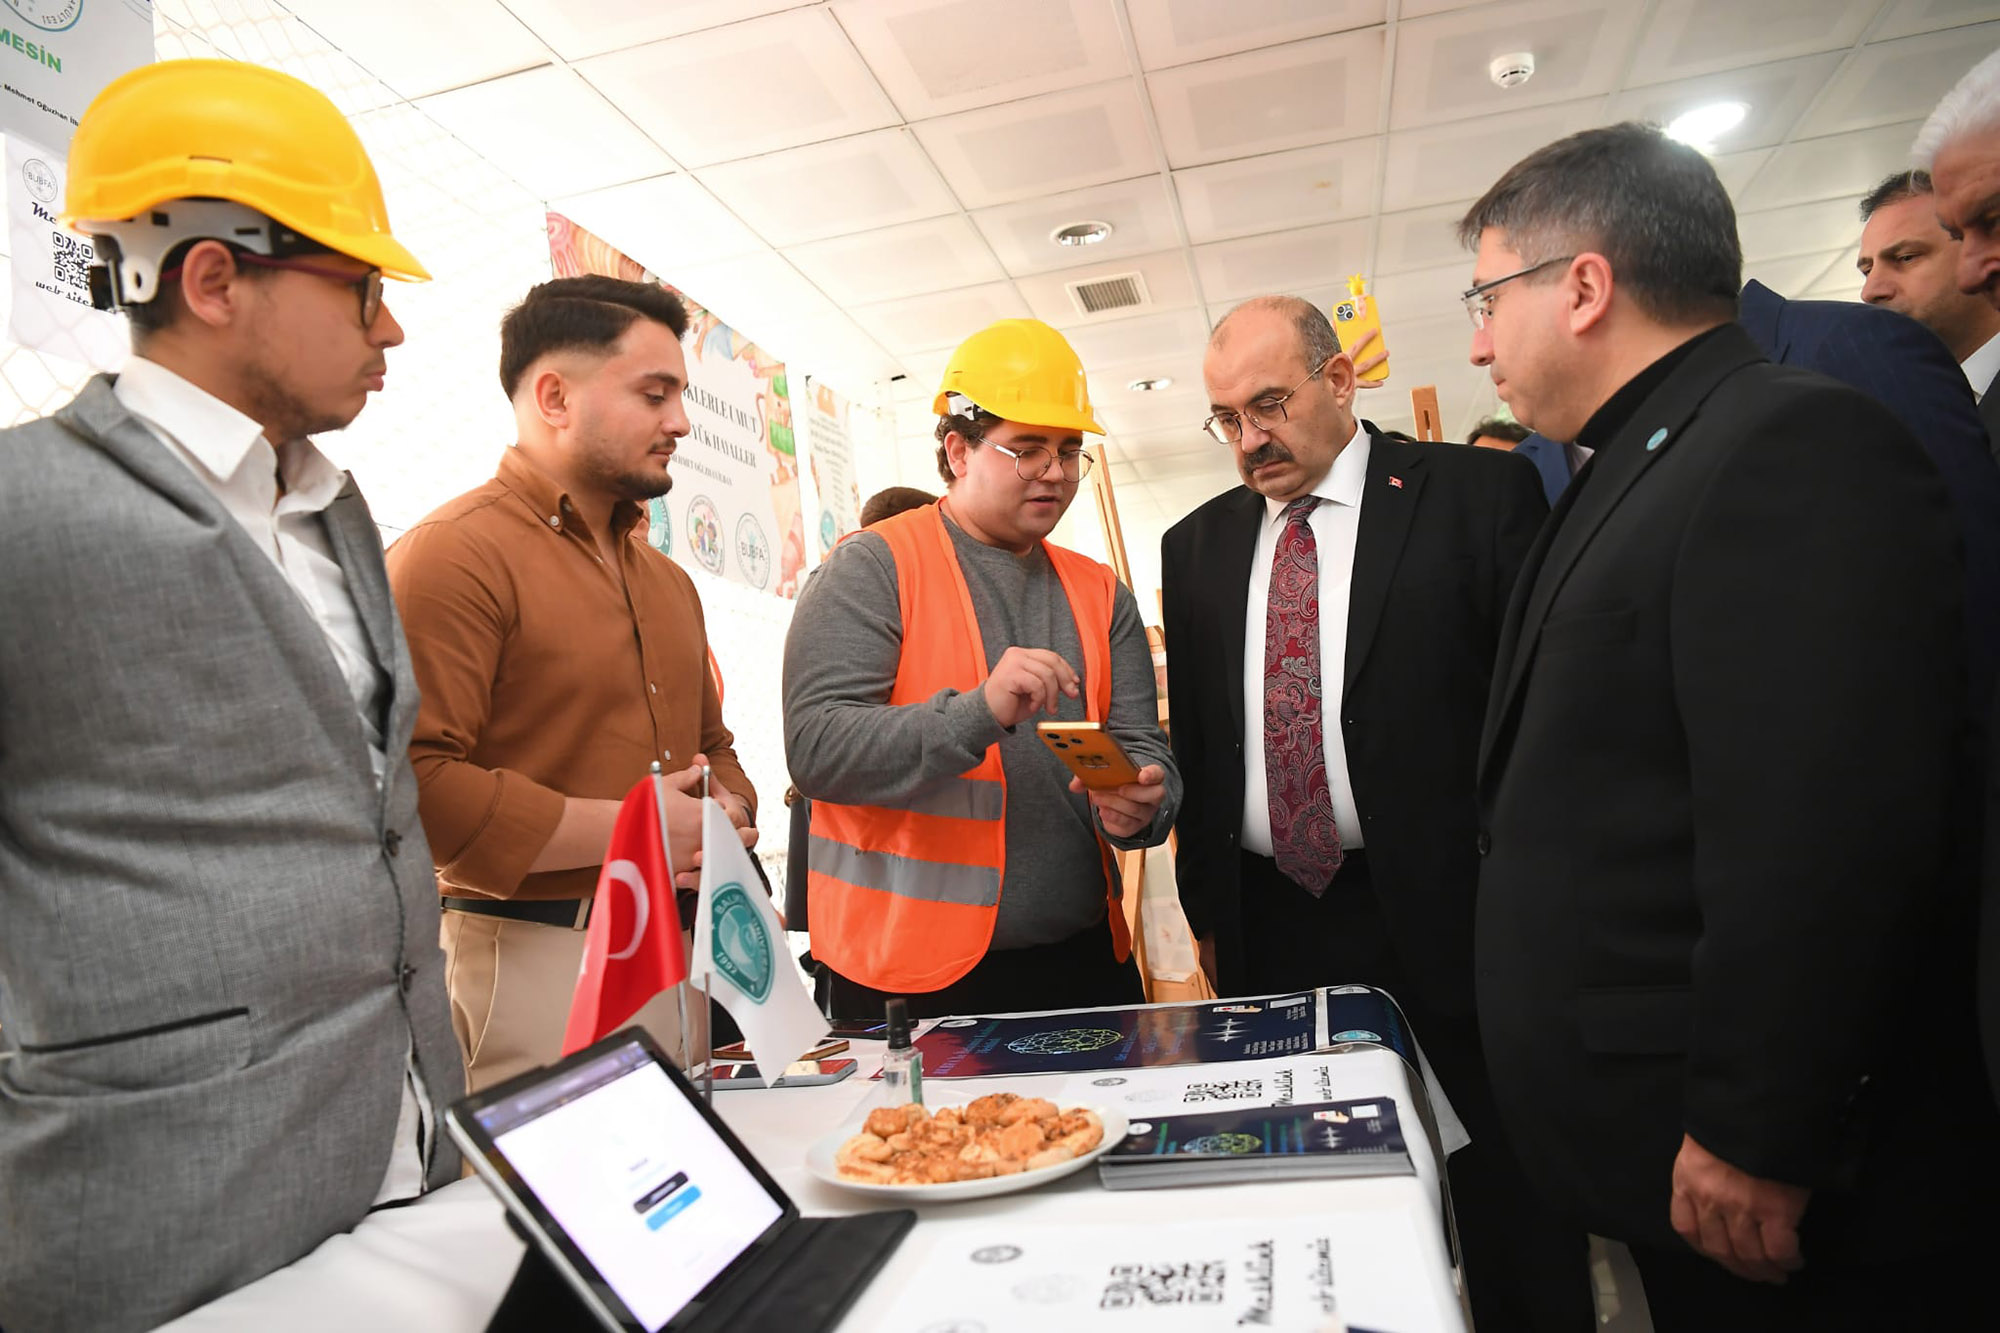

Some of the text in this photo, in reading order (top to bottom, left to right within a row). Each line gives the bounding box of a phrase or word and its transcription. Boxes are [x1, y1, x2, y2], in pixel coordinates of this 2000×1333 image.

[4, 83, 35, 105] Mehmet
[35, 281, 64, 295] web
[716, 951, 738, 975] 1992
